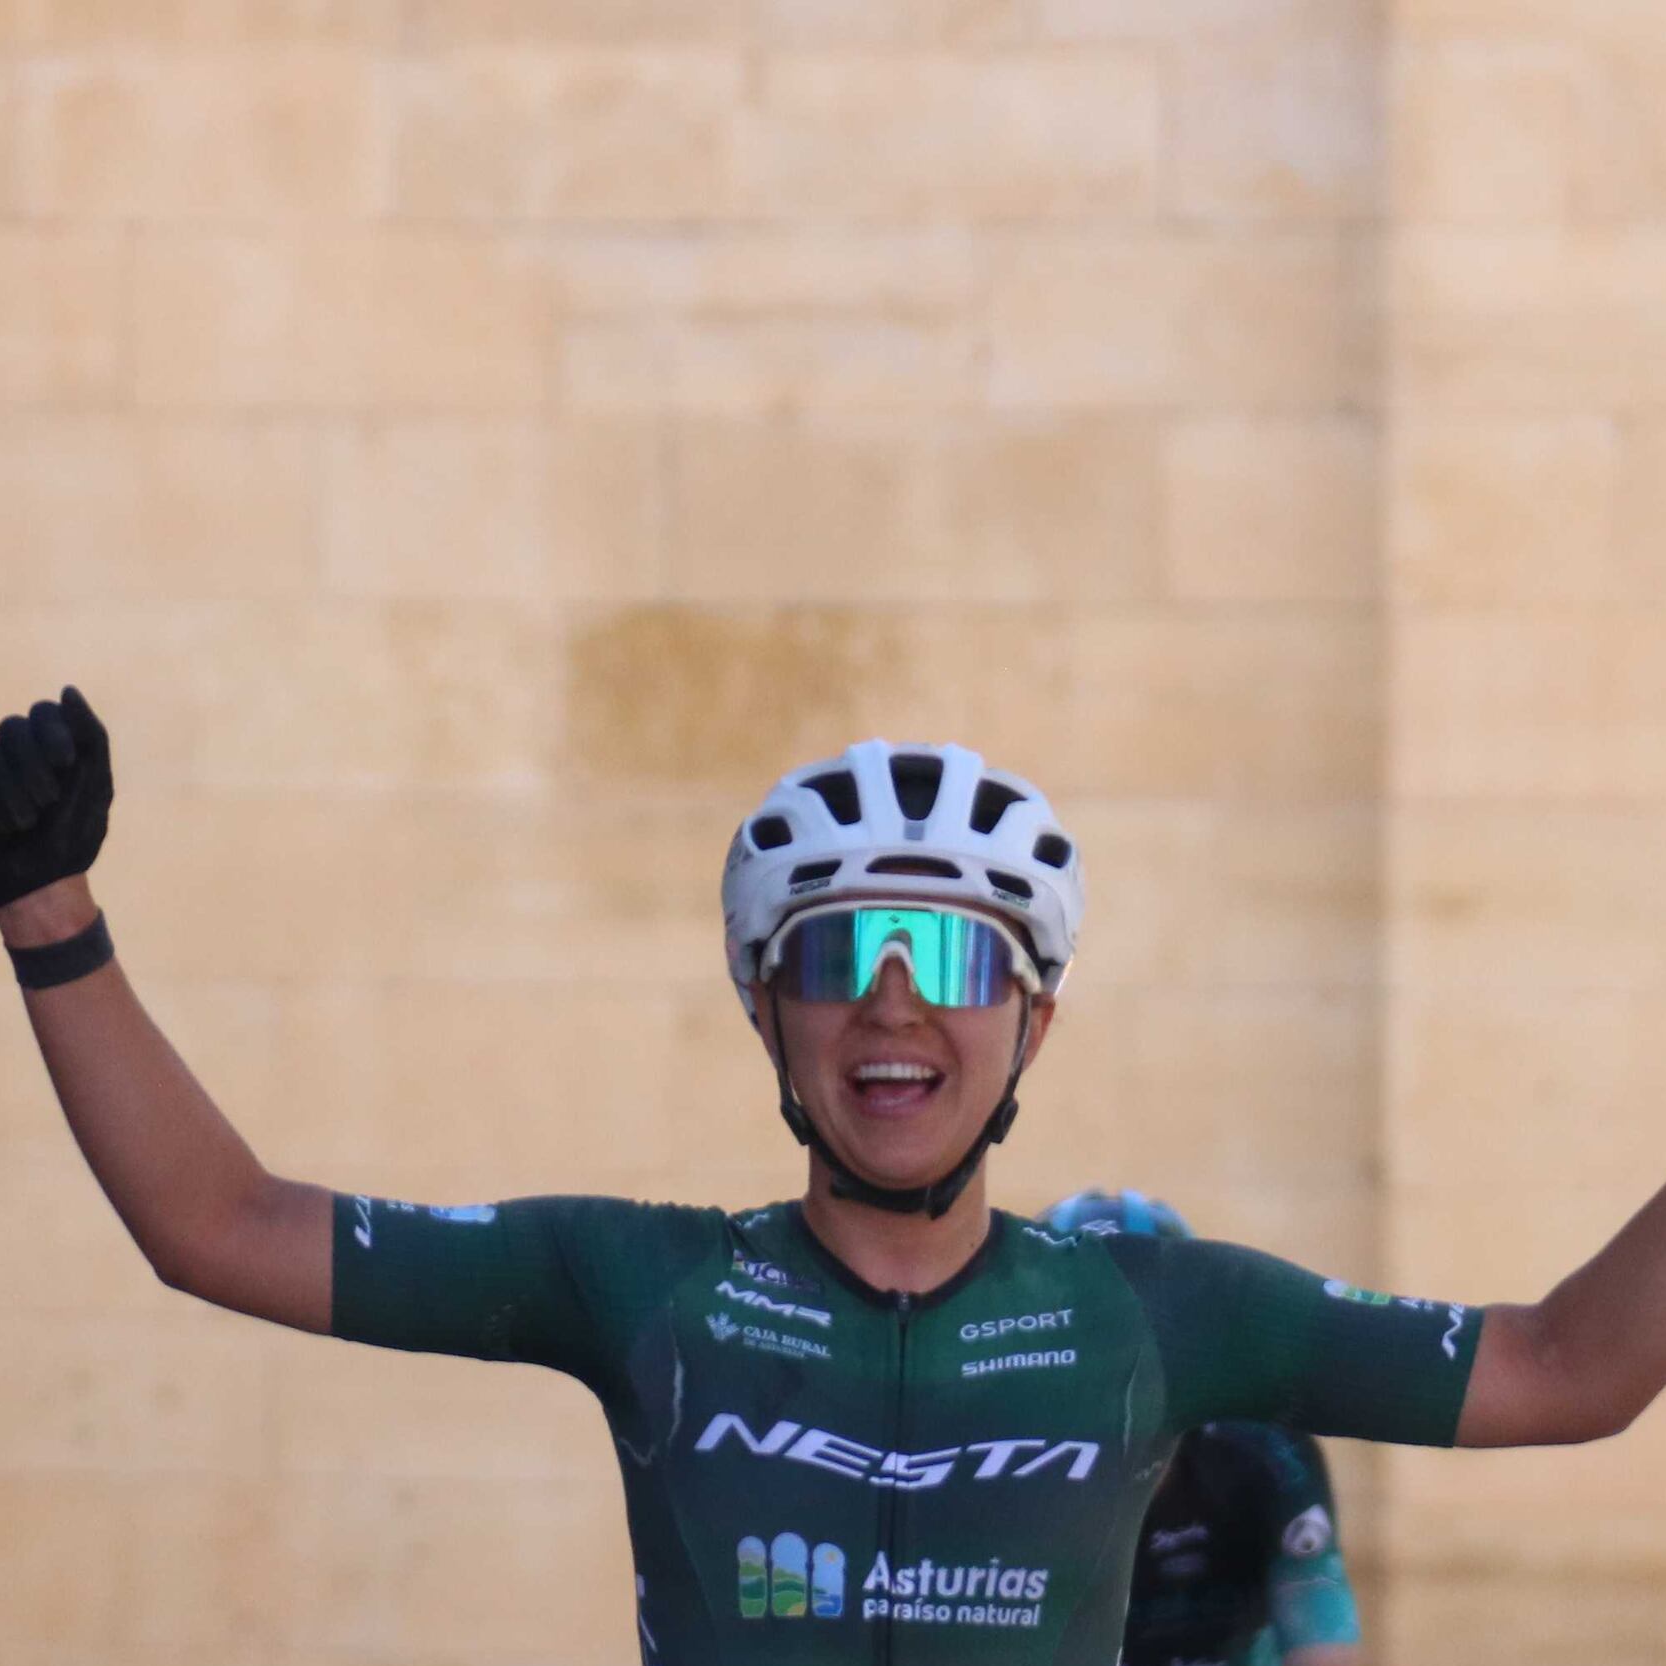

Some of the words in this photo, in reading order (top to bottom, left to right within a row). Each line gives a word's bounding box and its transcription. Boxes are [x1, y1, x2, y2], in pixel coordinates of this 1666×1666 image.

[960, 1308, 1073, 1340] GSPORT
[743, 1325, 778, 1343] CAJA
[781, 1334, 832, 1358] RURAL
[961, 1349, 1076, 1376] SHIMANO
[694, 1413, 1100, 1489] NESTA
[862, 1550, 1049, 1600] Asturias
[862, 1597, 952, 1621] paraíso
[957, 1603, 1041, 1627] natural
